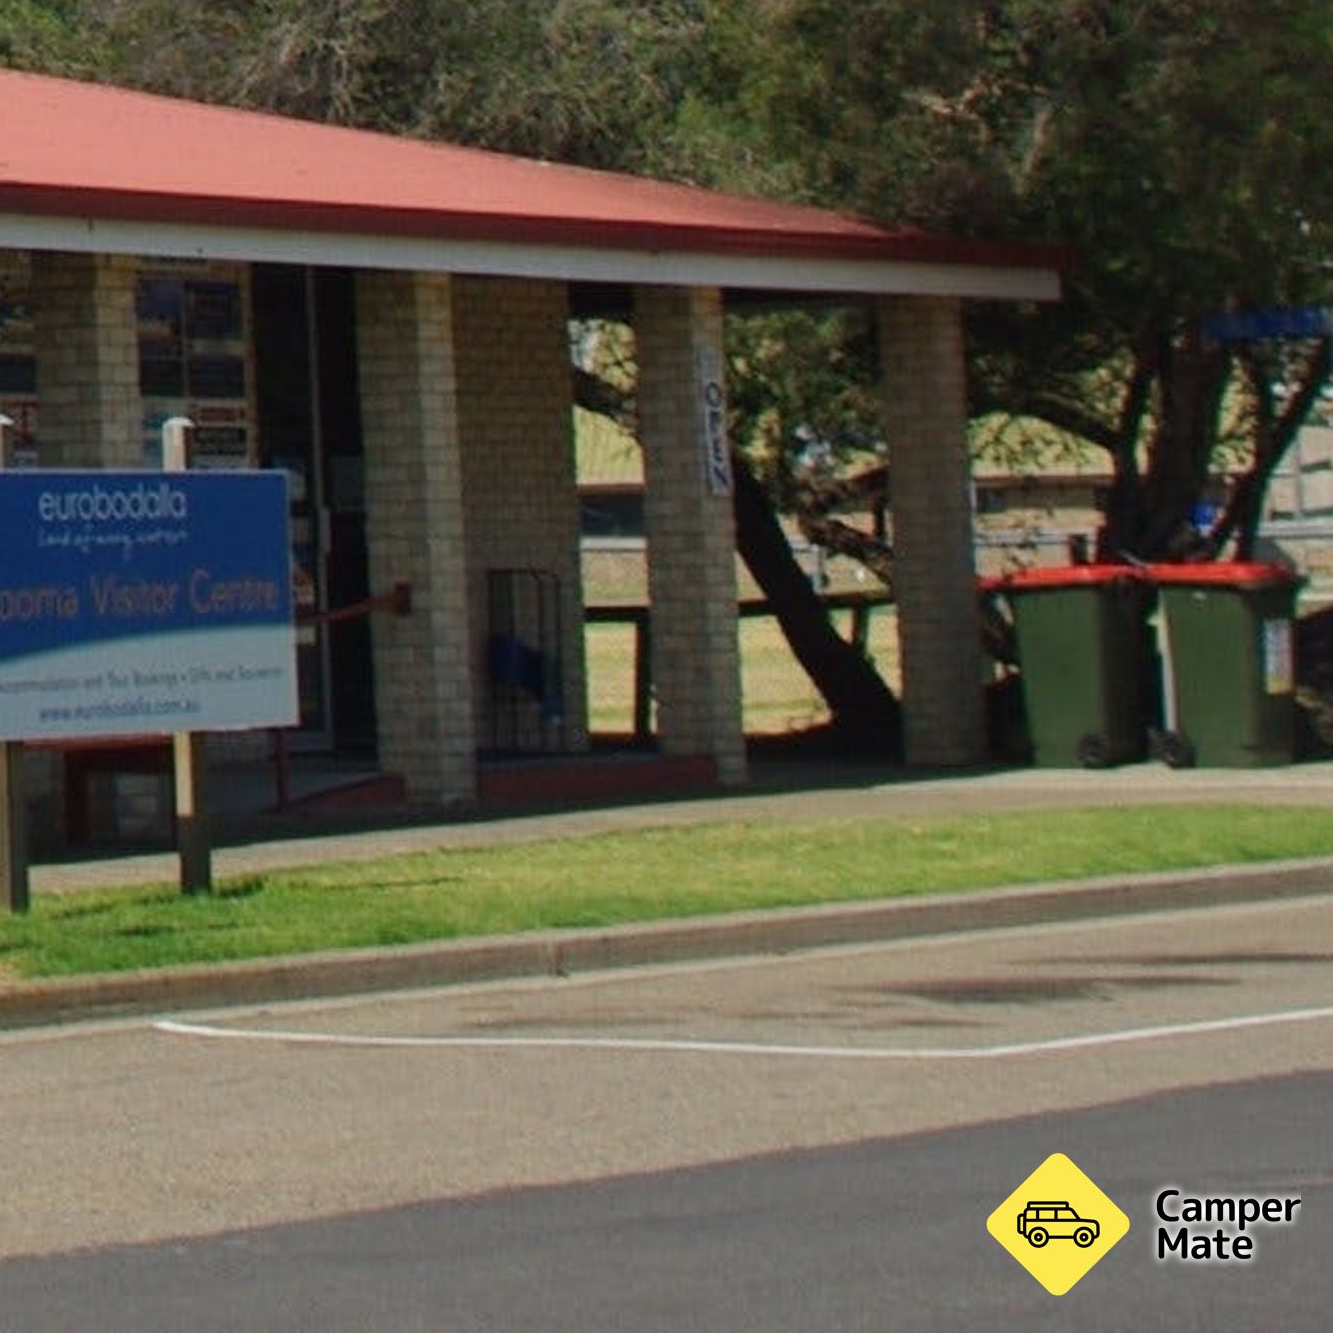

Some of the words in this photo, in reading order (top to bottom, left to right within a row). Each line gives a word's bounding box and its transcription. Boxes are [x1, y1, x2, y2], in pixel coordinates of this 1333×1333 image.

[38, 483, 186, 520] eurobodalla
[91, 573, 178, 615] Visitor
[191, 568, 277, 613] Centre
